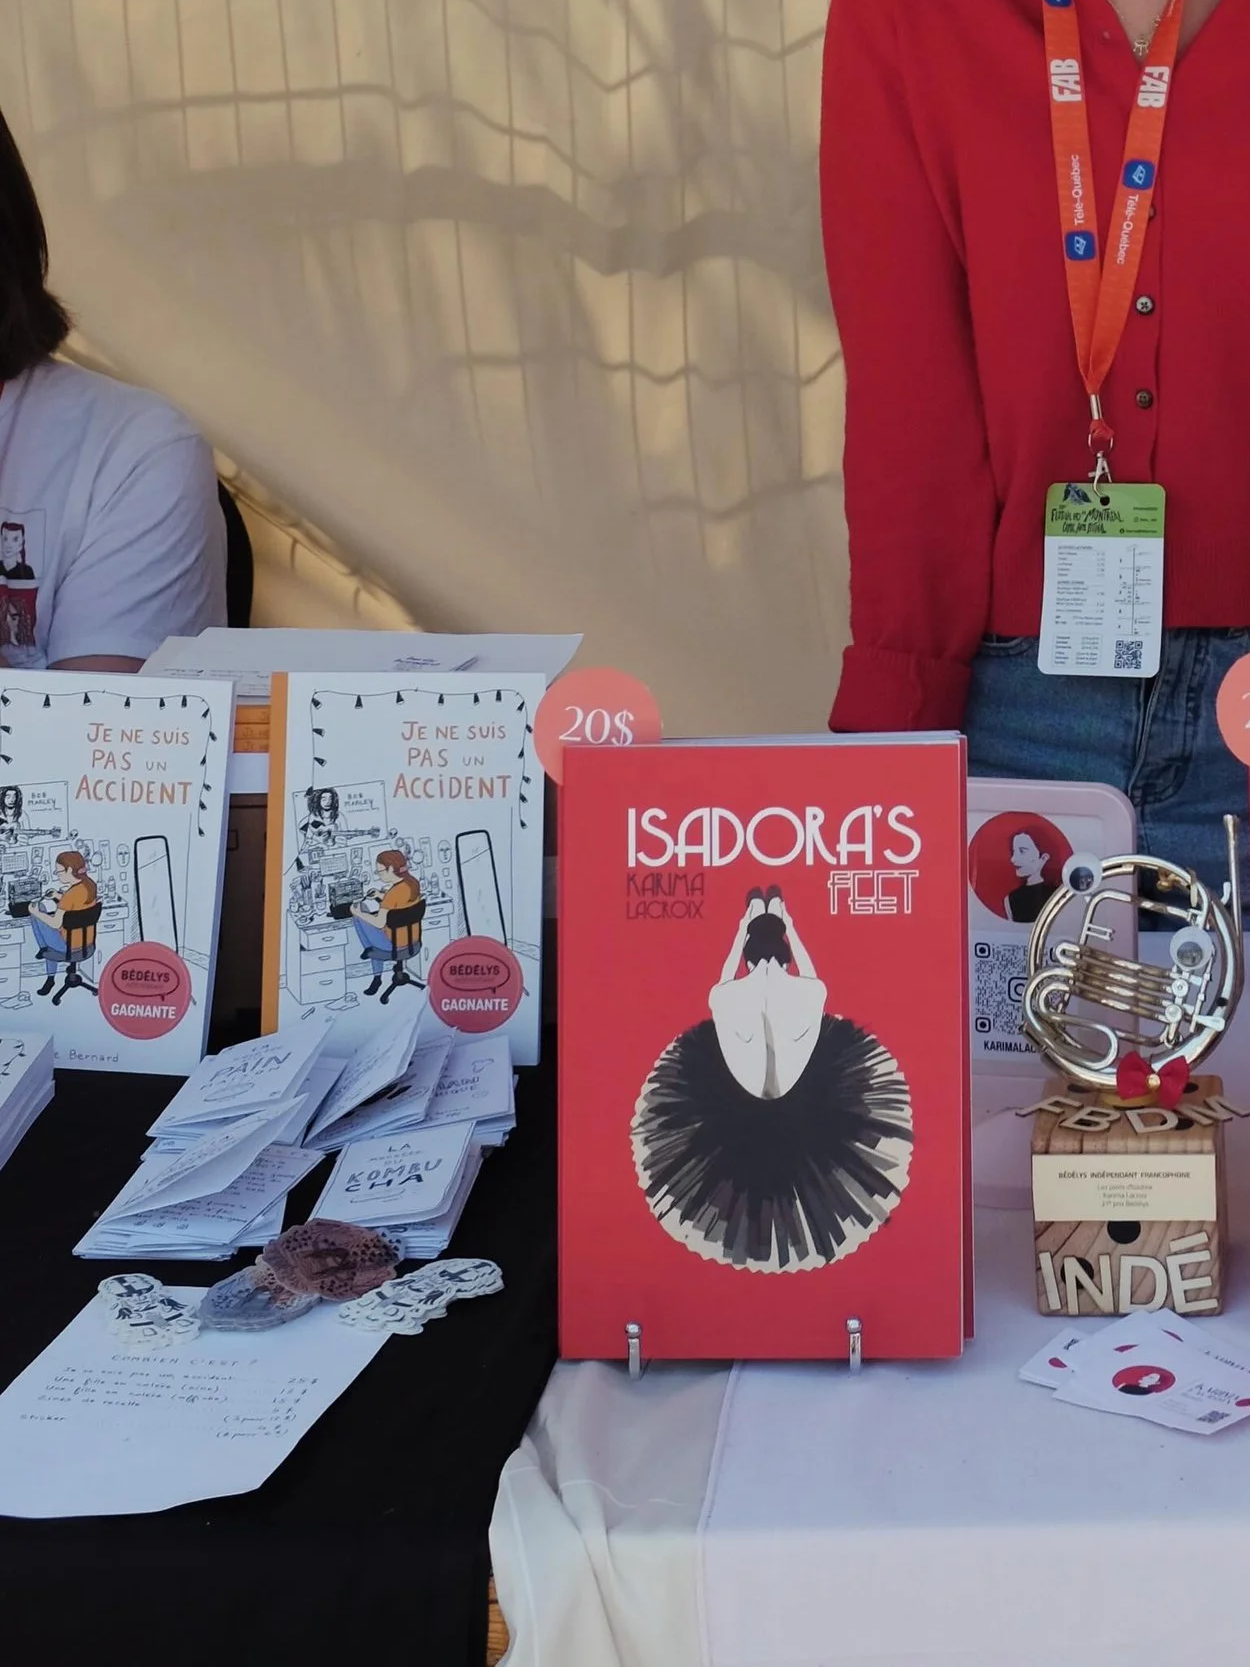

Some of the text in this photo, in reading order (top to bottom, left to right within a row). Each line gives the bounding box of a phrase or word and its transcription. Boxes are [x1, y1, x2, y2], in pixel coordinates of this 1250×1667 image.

[120, 727, 144, 744] NE
[435, 724, 459, 741] NE
[559, 705, 635, 746] 20$
[91, 749, 167, 772] PAS UN
[407, 747, 485, 768] PAS UN
[627, 804, 922, 868] ISADORA'S
[627, 872, 705, 897] KARIMA
[826, 869, 920, 915] FEET
[627, 899, 704, 921] LACROIX
[121, 968, 170, 983] BÉDÉLYS
[449, 963, 501, 976] BÉDÉLYS
[110, 1002, 177, 1019] GAGNANTE
[441, 998, 509, 1012] GAGNANTE
[69, 1049, 119, 1063] Bernard
[346, 1157, 443, 1184] KOMBU
[345, 1173, 424, 1194] CHA
[1038, 1231, 1219, 1315] INDÉ
